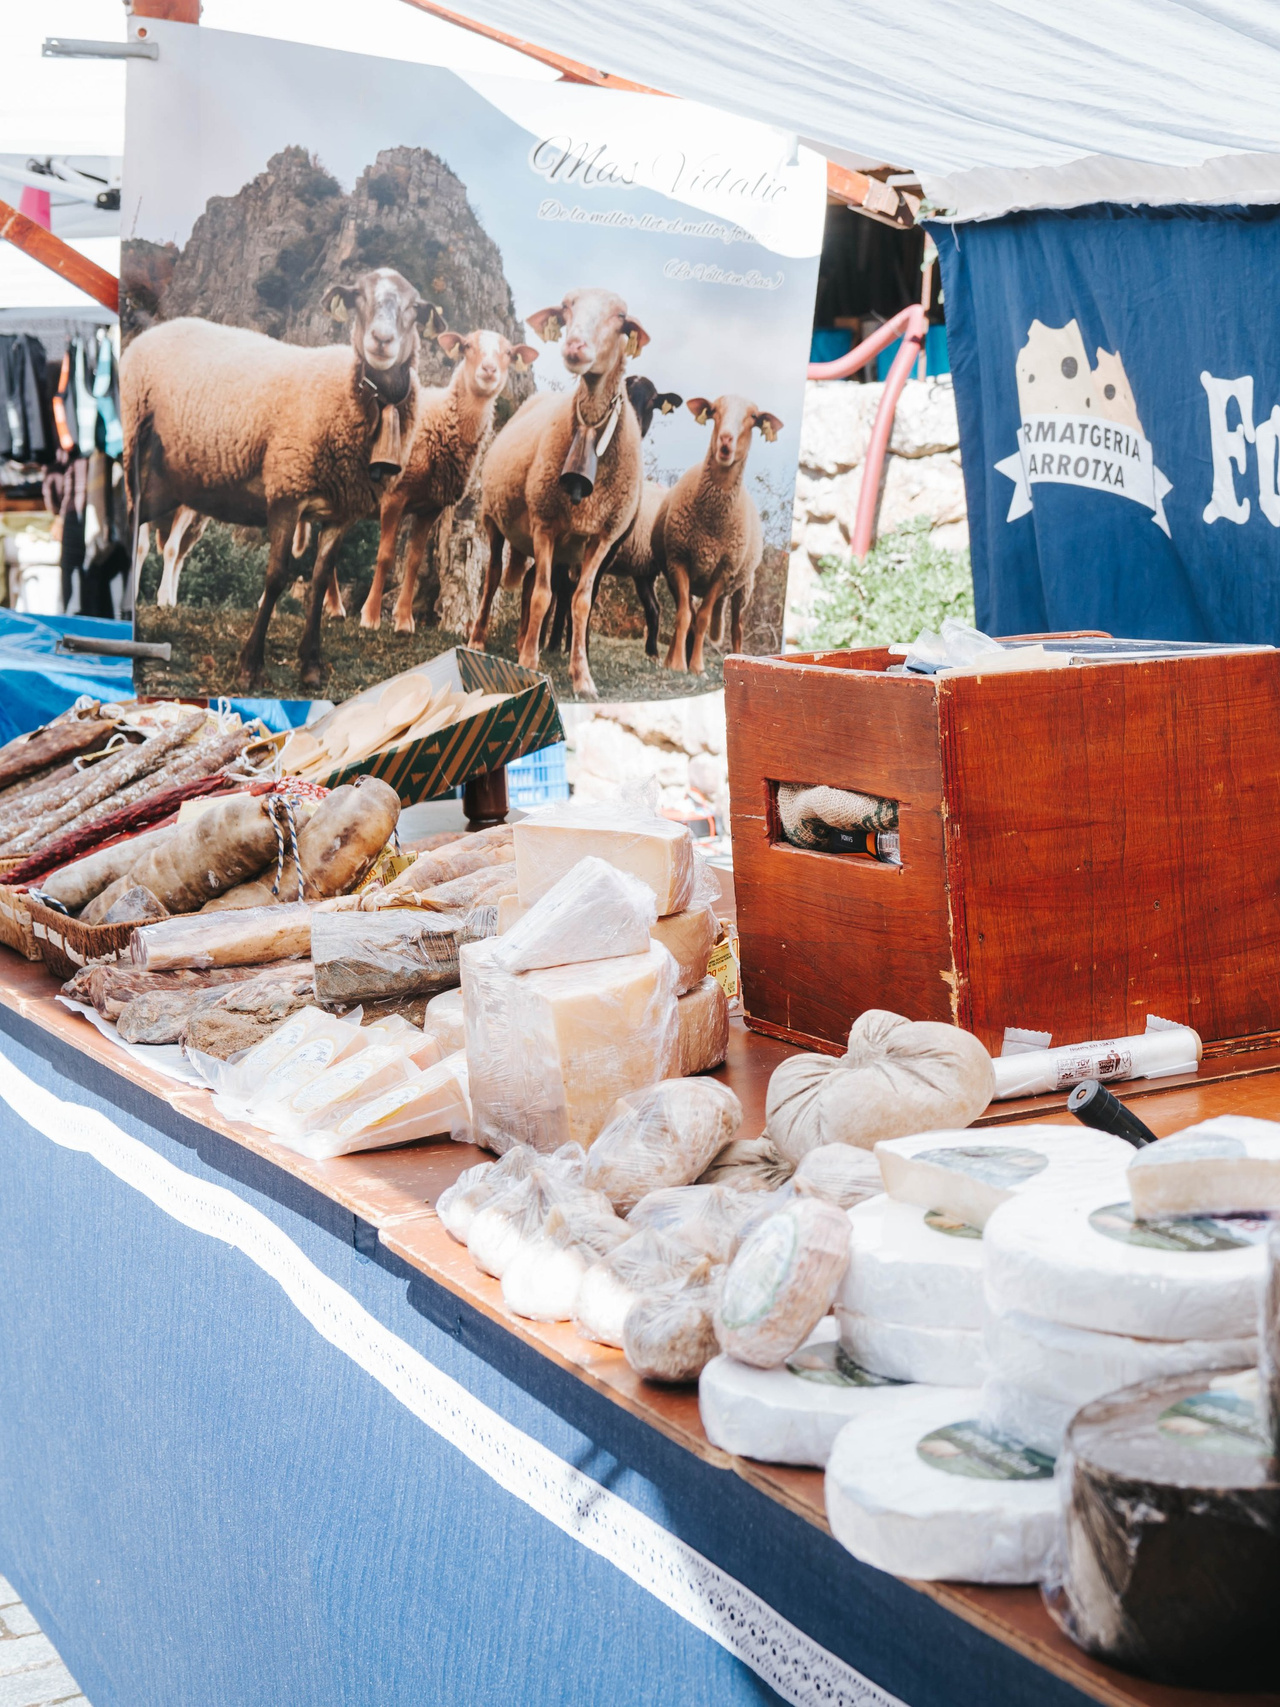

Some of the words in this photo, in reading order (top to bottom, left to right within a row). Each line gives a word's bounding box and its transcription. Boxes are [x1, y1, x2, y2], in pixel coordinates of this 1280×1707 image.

[532, 134, 638, 185] Mas
[540, 199, 568, 220] De
[570, 207, 586, 221] la
[589, 211, 635, 227] millor
[640, 214, 662, 229] llet
[666, 218, 681, 231] el
[683, 221, 727, 238] millor
